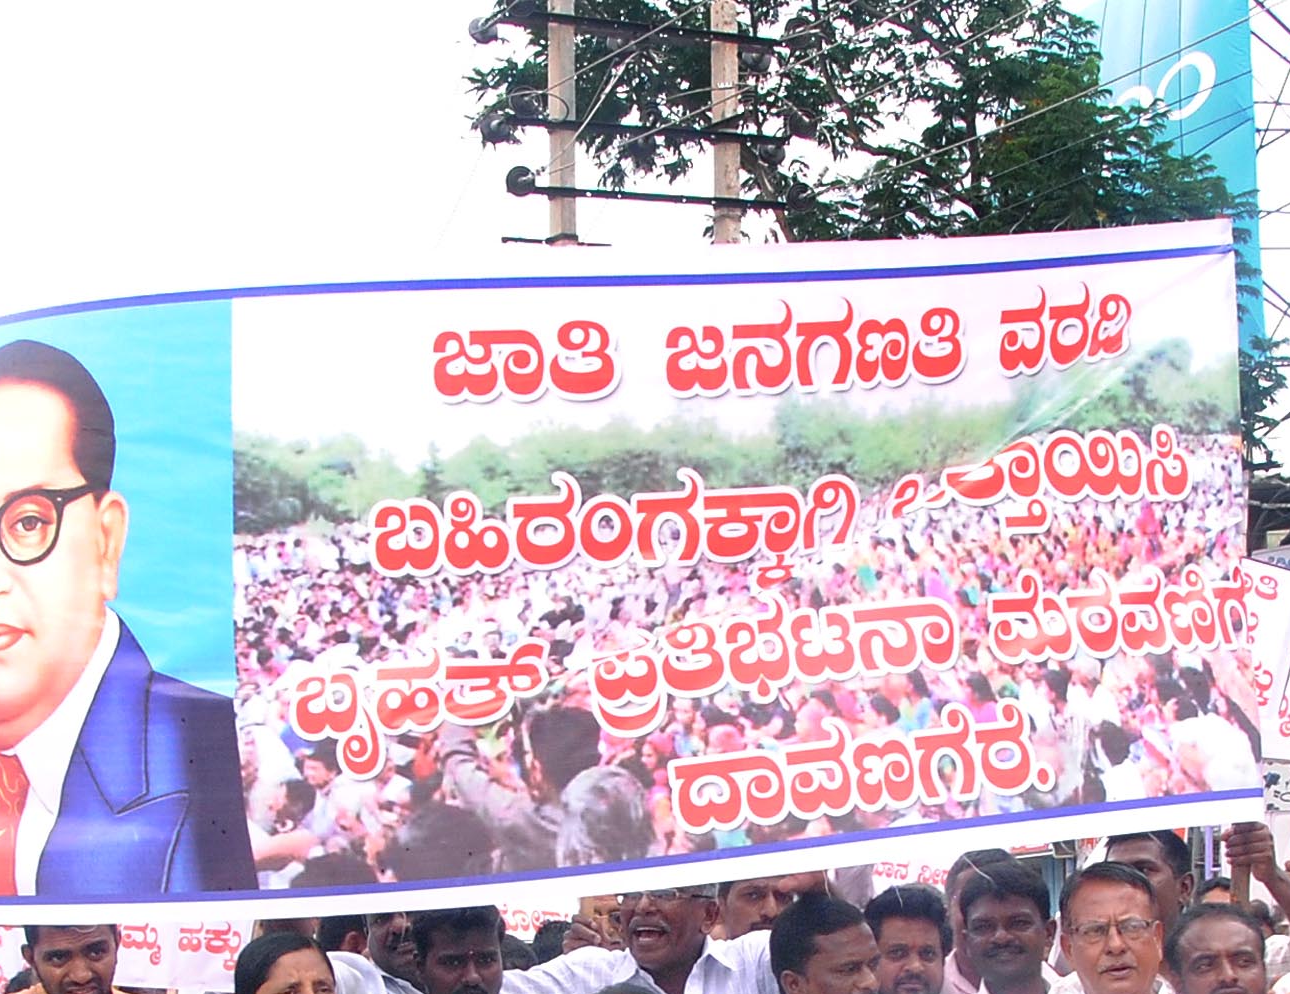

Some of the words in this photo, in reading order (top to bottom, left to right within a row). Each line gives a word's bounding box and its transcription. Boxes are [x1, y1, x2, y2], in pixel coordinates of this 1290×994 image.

[433, 319, 616, 396] ಜಾತಿ
[666, 297, 963, 391] ಜನಗಣತಿ
[999, 282, 1133, 371] ವರದಿ
[374, 468, 856, 585] ಬಹಿರಂಗಕ್ಕಾಗಿ
[295, 643, 545, 774] ಬೃಹತ್
[593, 595, 956, 731] ಪ್ರತಿಭಟನಾ
[990, 566, 1249, 661] ಮೆರವಣಿಗೆ
[675, 702, 1050, 828] ದಾವಣಗೆರೆ.
[118, 922, 163, 966] ಮ್ಮ
